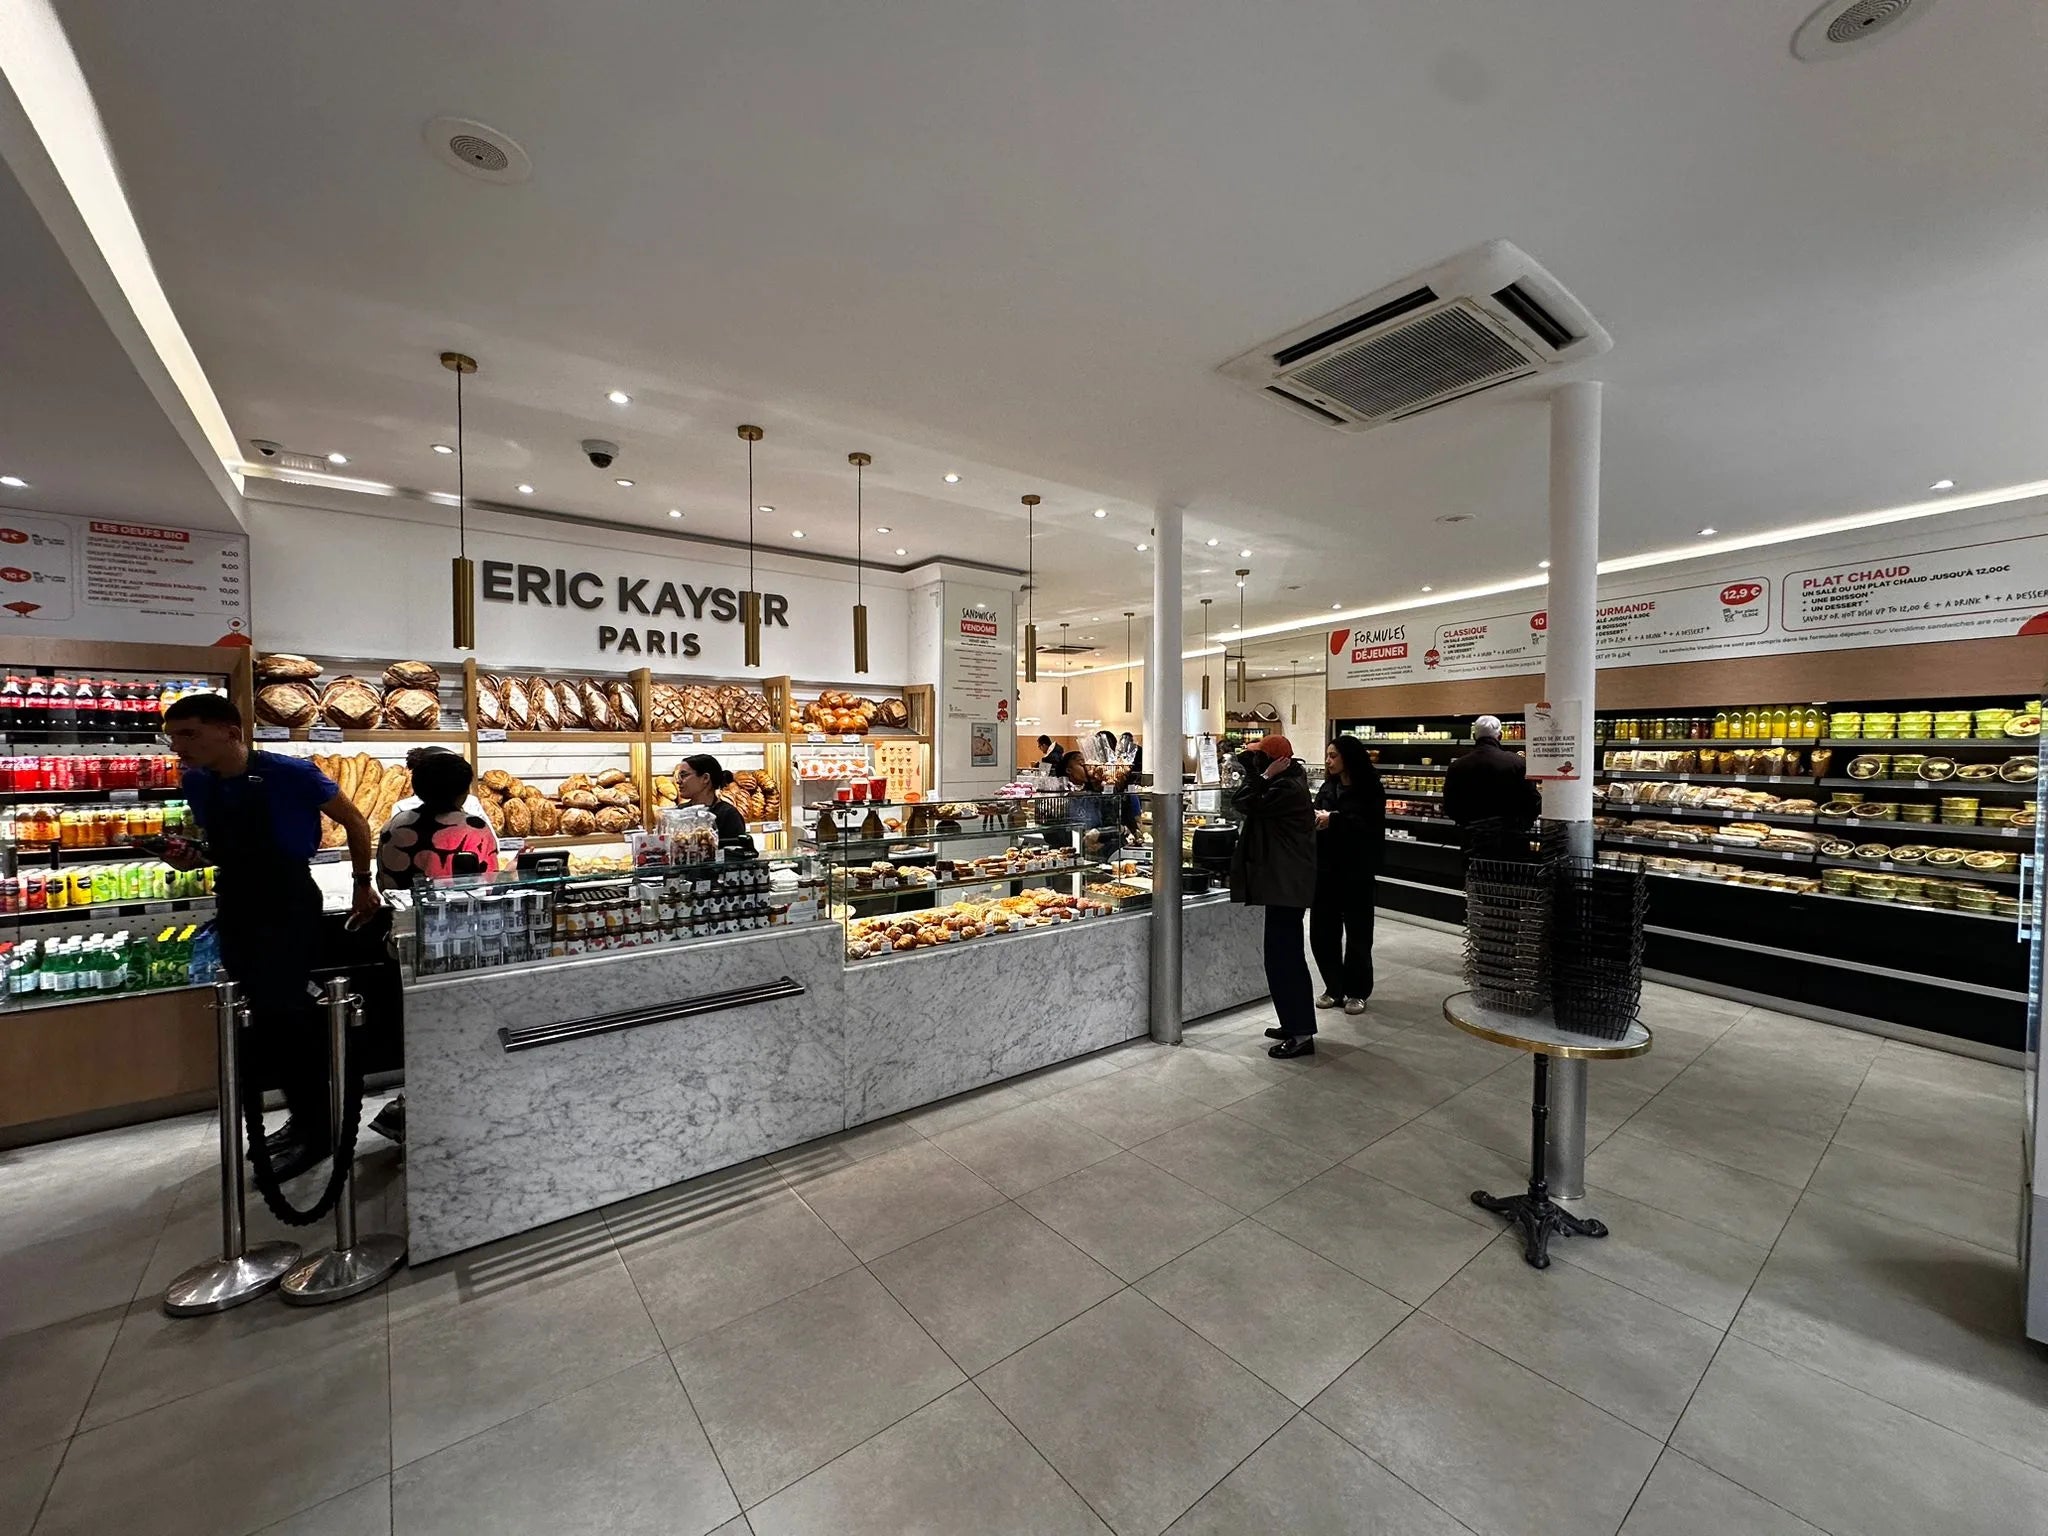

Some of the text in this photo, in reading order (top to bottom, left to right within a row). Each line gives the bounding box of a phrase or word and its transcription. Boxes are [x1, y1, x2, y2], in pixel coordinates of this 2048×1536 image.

[94, 523, 184, 540] LES OEUFS BIO
[483, 560, 604, 610] ERIC
[1803, 565, 1911, 589] PLAT CHAUD
[1867, 580, 1891, 588] PLAT
[1893, 575, 1927, 585] CHAUD
[1929, 568, 1973, 581] JUSQU'À
[1723, 588, 1748, 600] 12,9
[1832, 591, 1868, 601] BOISSON
[1825, 601, 1863, 611] DESSERT
[1875, 607, 1886, 615] UP
[1945, 600, 1952, 608] A
[1954, 597, 1981, 606] DRINK
[962, 623, 996, 634] VENDÔME
[1354, 624, 1405, 647] FORMULES
[1443, 626, 1488, 638] CLASSIQUE
[599, 625, 701, 657] PARIS
